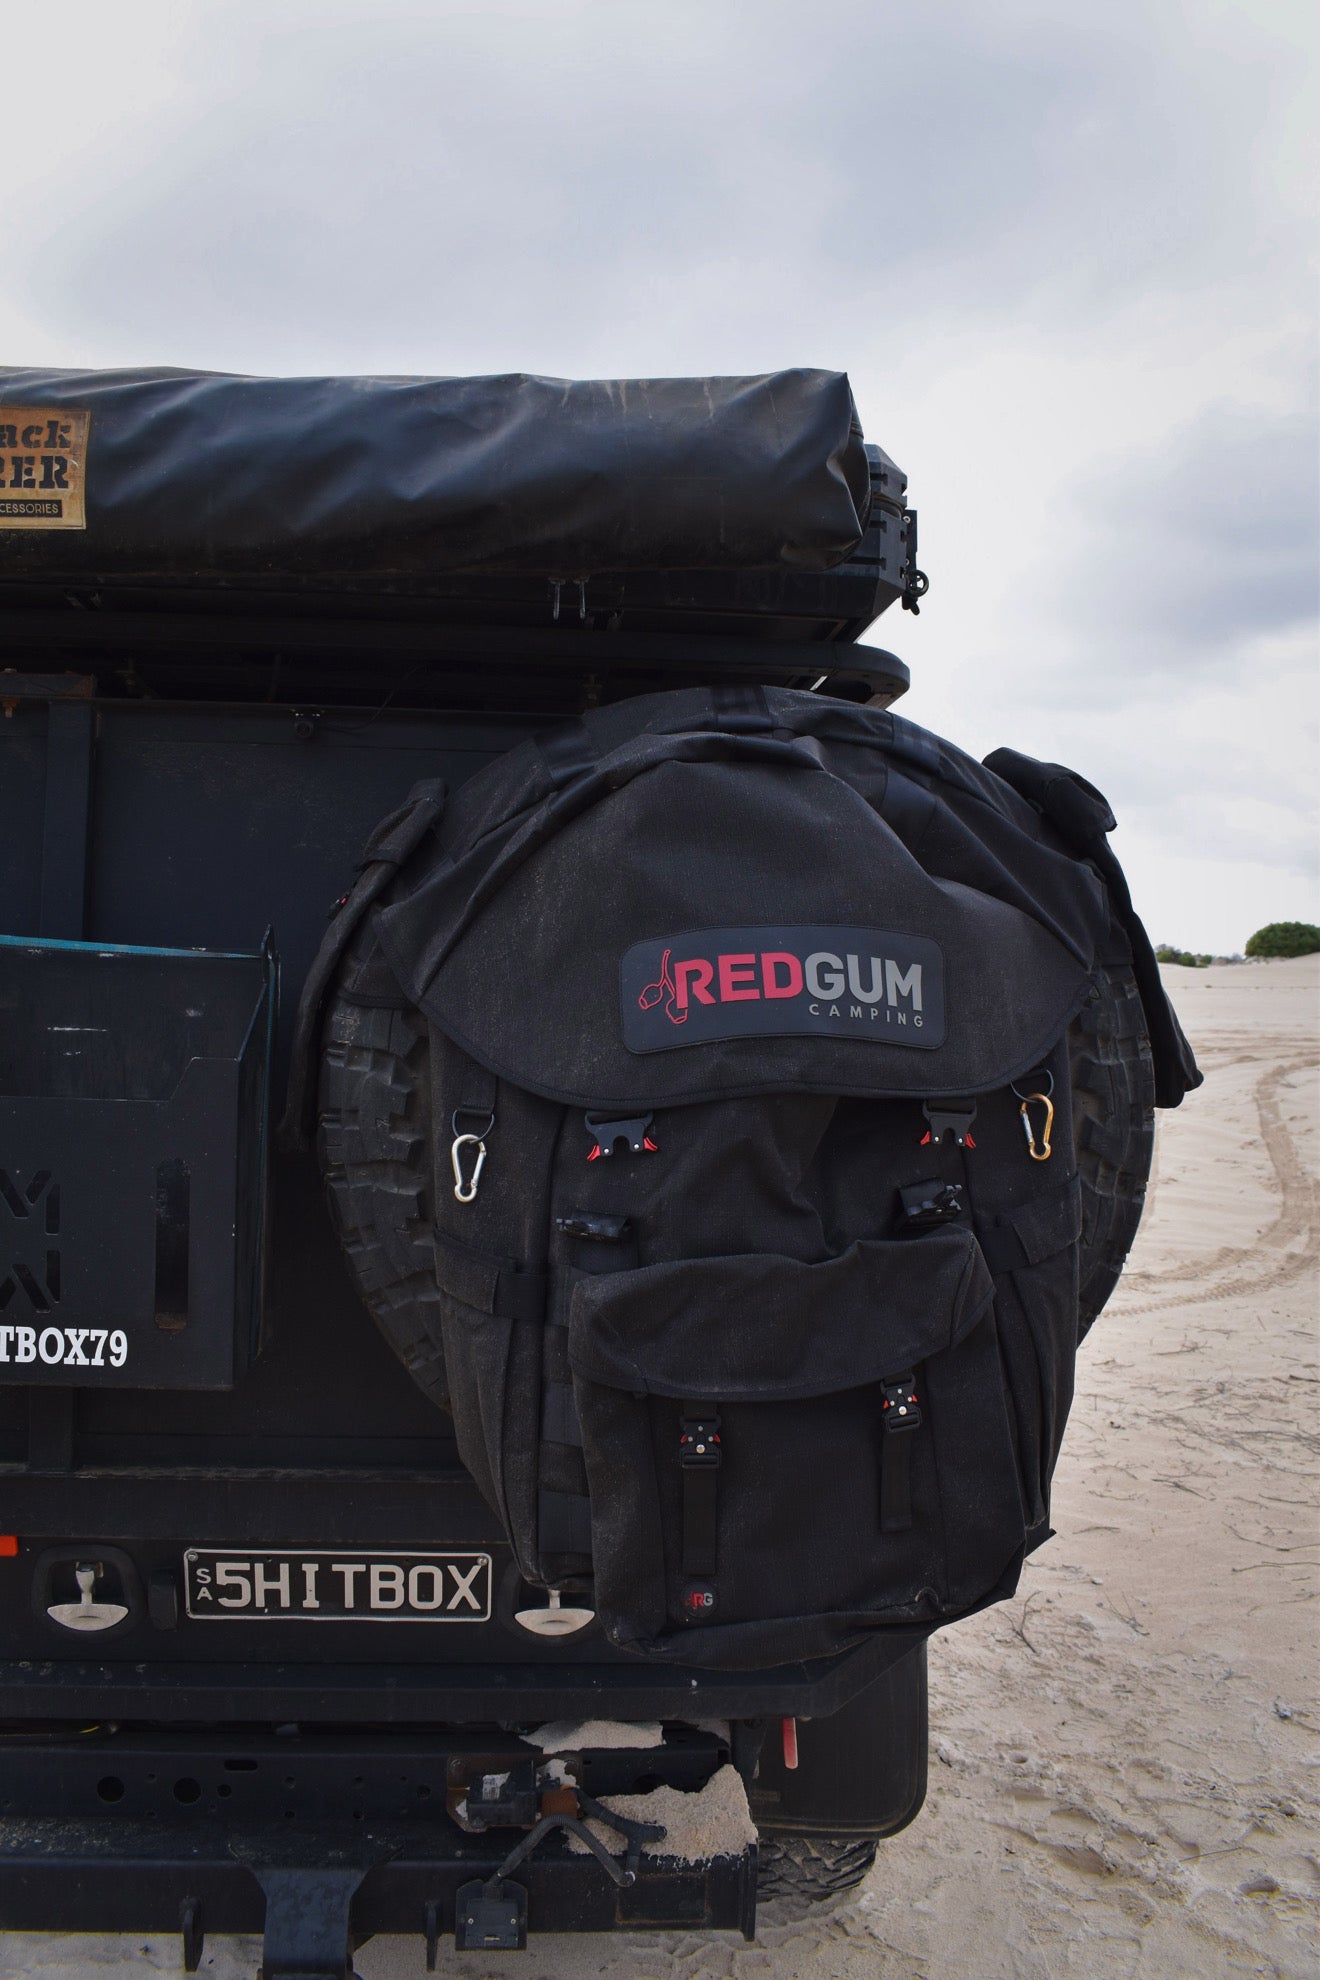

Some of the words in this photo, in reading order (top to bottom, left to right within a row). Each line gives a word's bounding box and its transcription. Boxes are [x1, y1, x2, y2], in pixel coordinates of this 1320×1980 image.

[0, 455, 69, 488] ER
[674, 952, 923, 1012] REDGUM
[808, 1003, 924, 1028] CAMPING
[692, 1592, 713, 1608] RG
